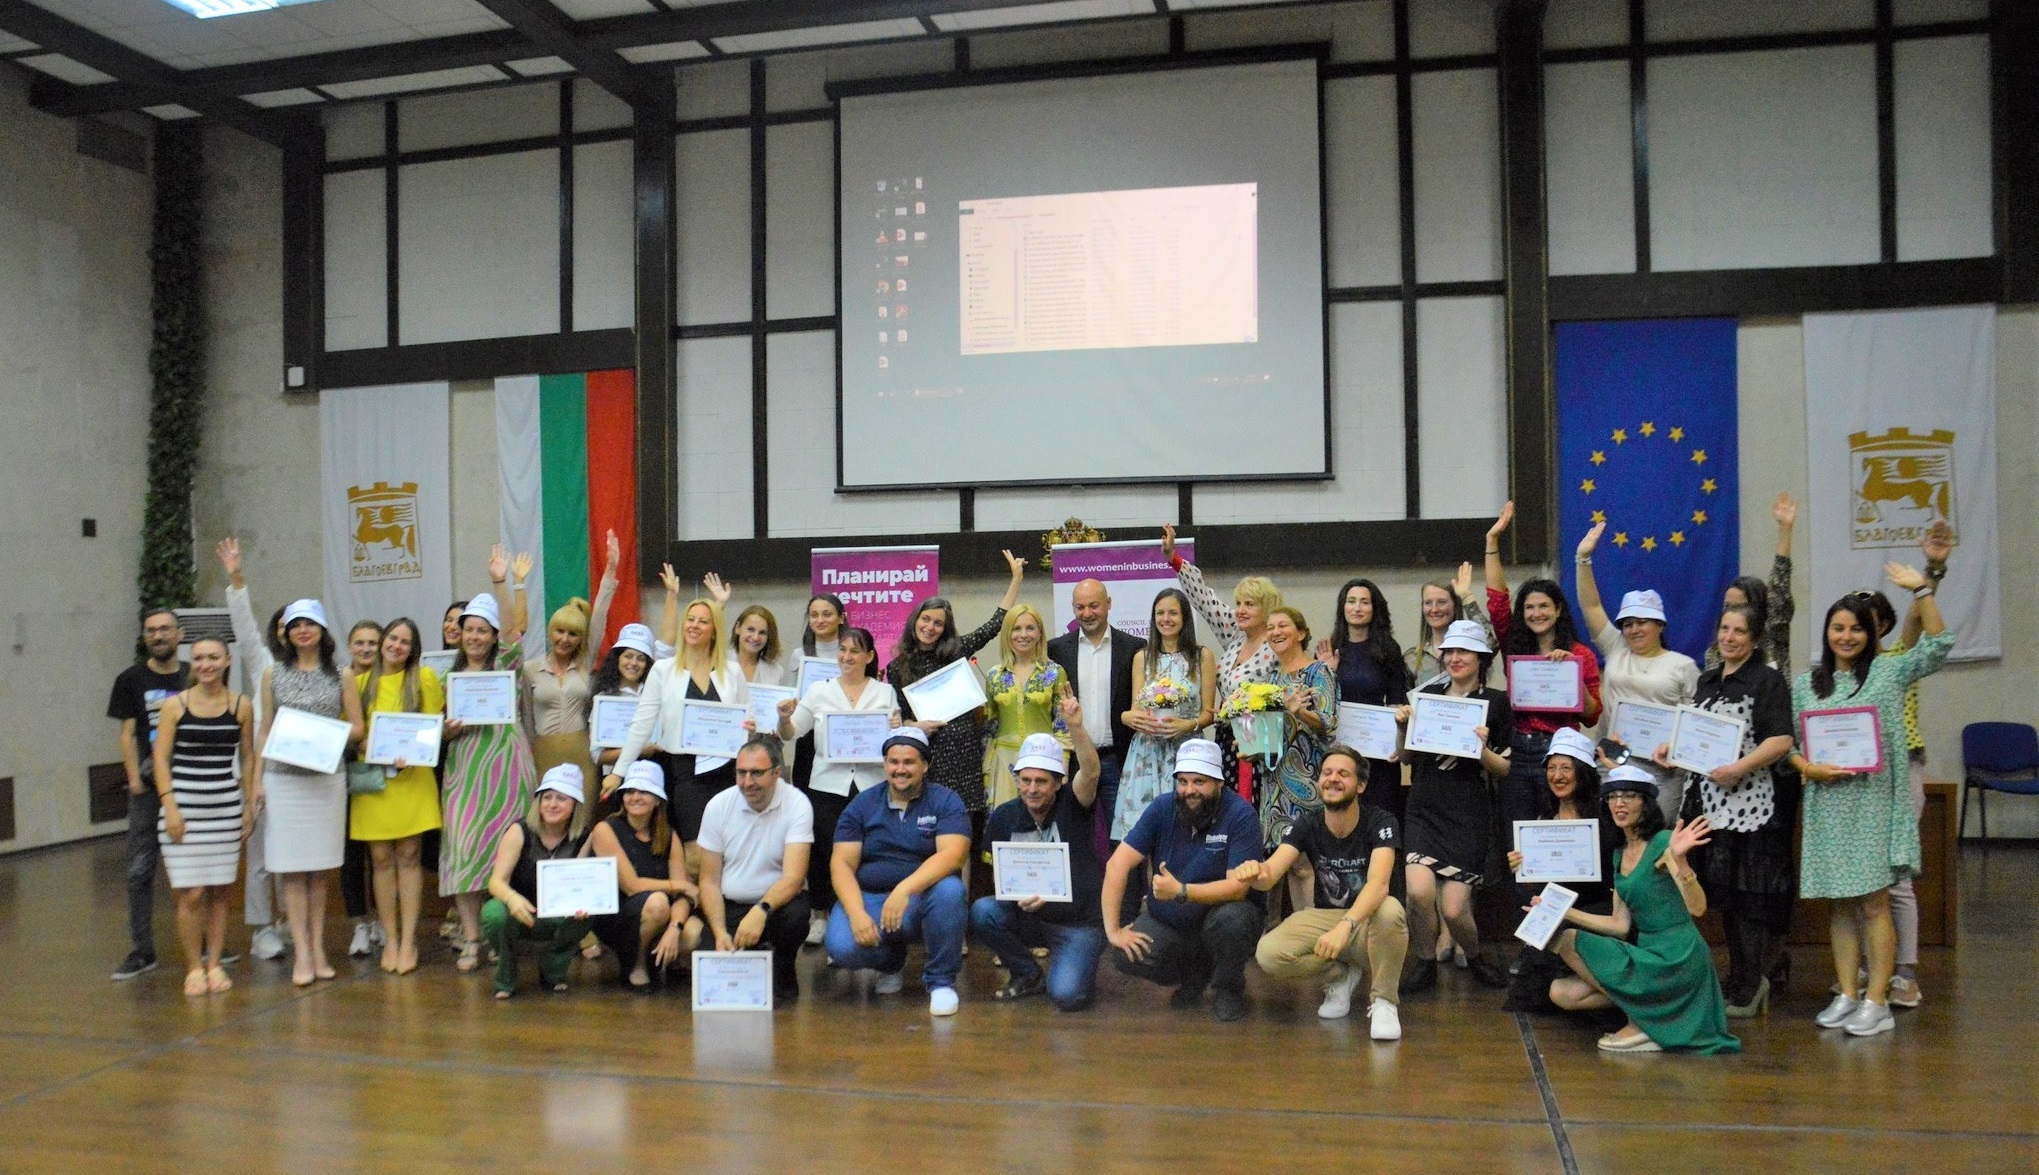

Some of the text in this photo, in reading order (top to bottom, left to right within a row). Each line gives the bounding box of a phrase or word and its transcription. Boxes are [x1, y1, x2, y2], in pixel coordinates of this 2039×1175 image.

[1059, 561, 1173, 573] www.womeninbusines
[822, 564, 929, 586] Планирай
[832, 589, 914, 605] ечтите
[850, 611, 892, 620] БИЗНЕС
[1116, 619, 1147, 627] COUNCIL
